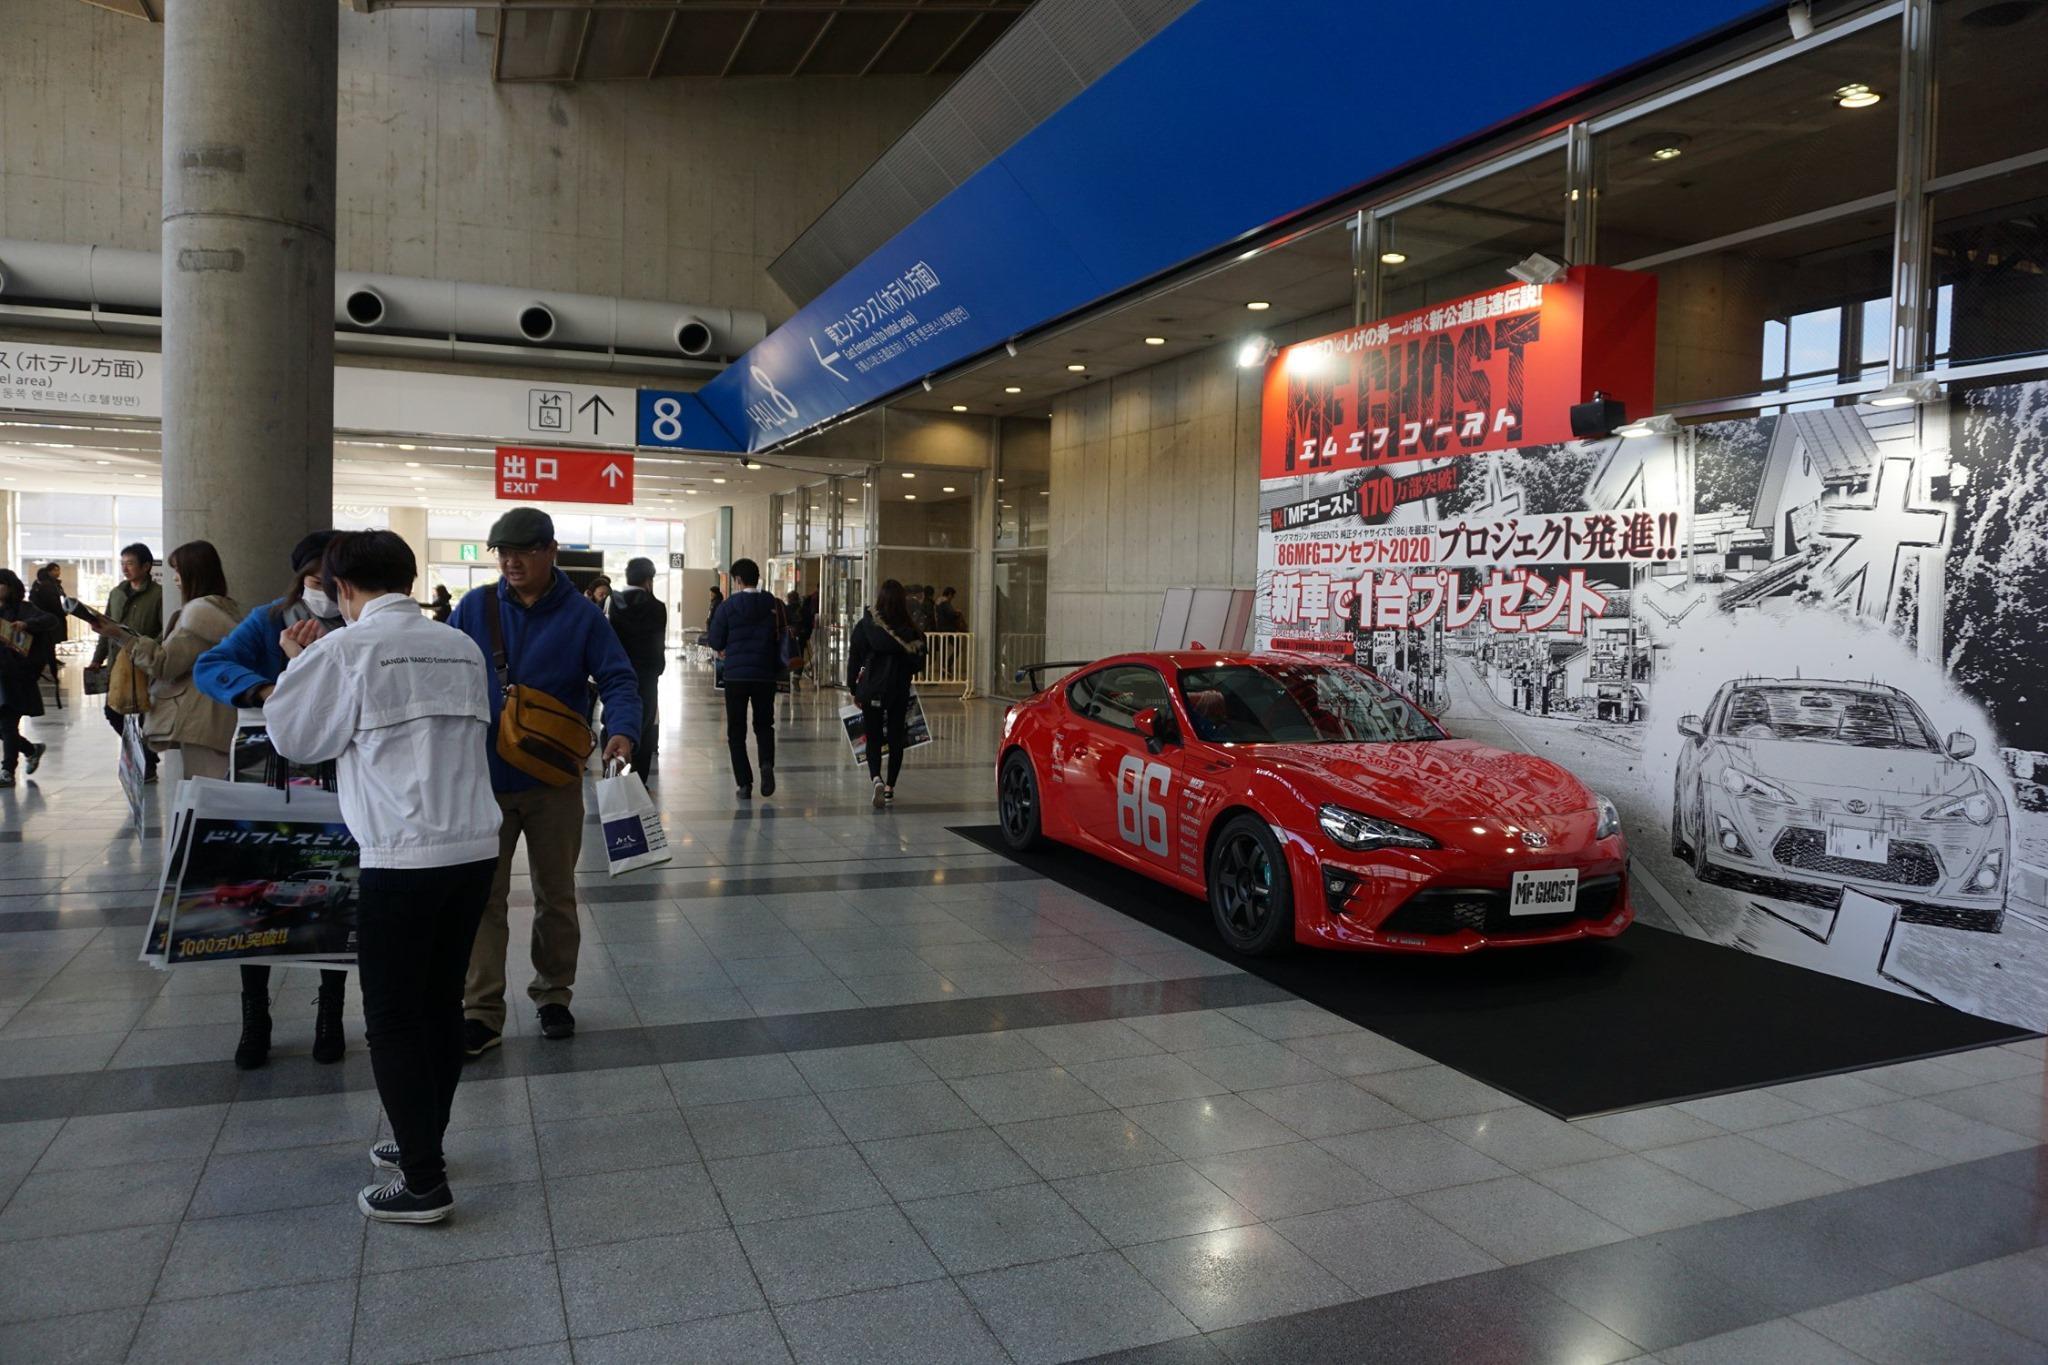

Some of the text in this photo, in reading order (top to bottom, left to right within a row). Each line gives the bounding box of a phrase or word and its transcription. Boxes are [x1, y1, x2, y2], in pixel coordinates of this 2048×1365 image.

[15, 376, 53, 388] area)
[745, 365, 799, 432] HALL 8
[1357, 310, 1542, 463] GHOST
[652, 397, 682, 441] 8
[503, 455, 559, 481] 出口
[503, 481, 539, 495] EXIT
[1310, 530, 1339, 540] PRESENTS
[1271, 568, 1608, 635] 新車で1台プレゼント
[380, 656, 408, 667] BANDAI
[408, 656, 433, 664] NAMCO
[1117, 754, 1172, 857] 86
